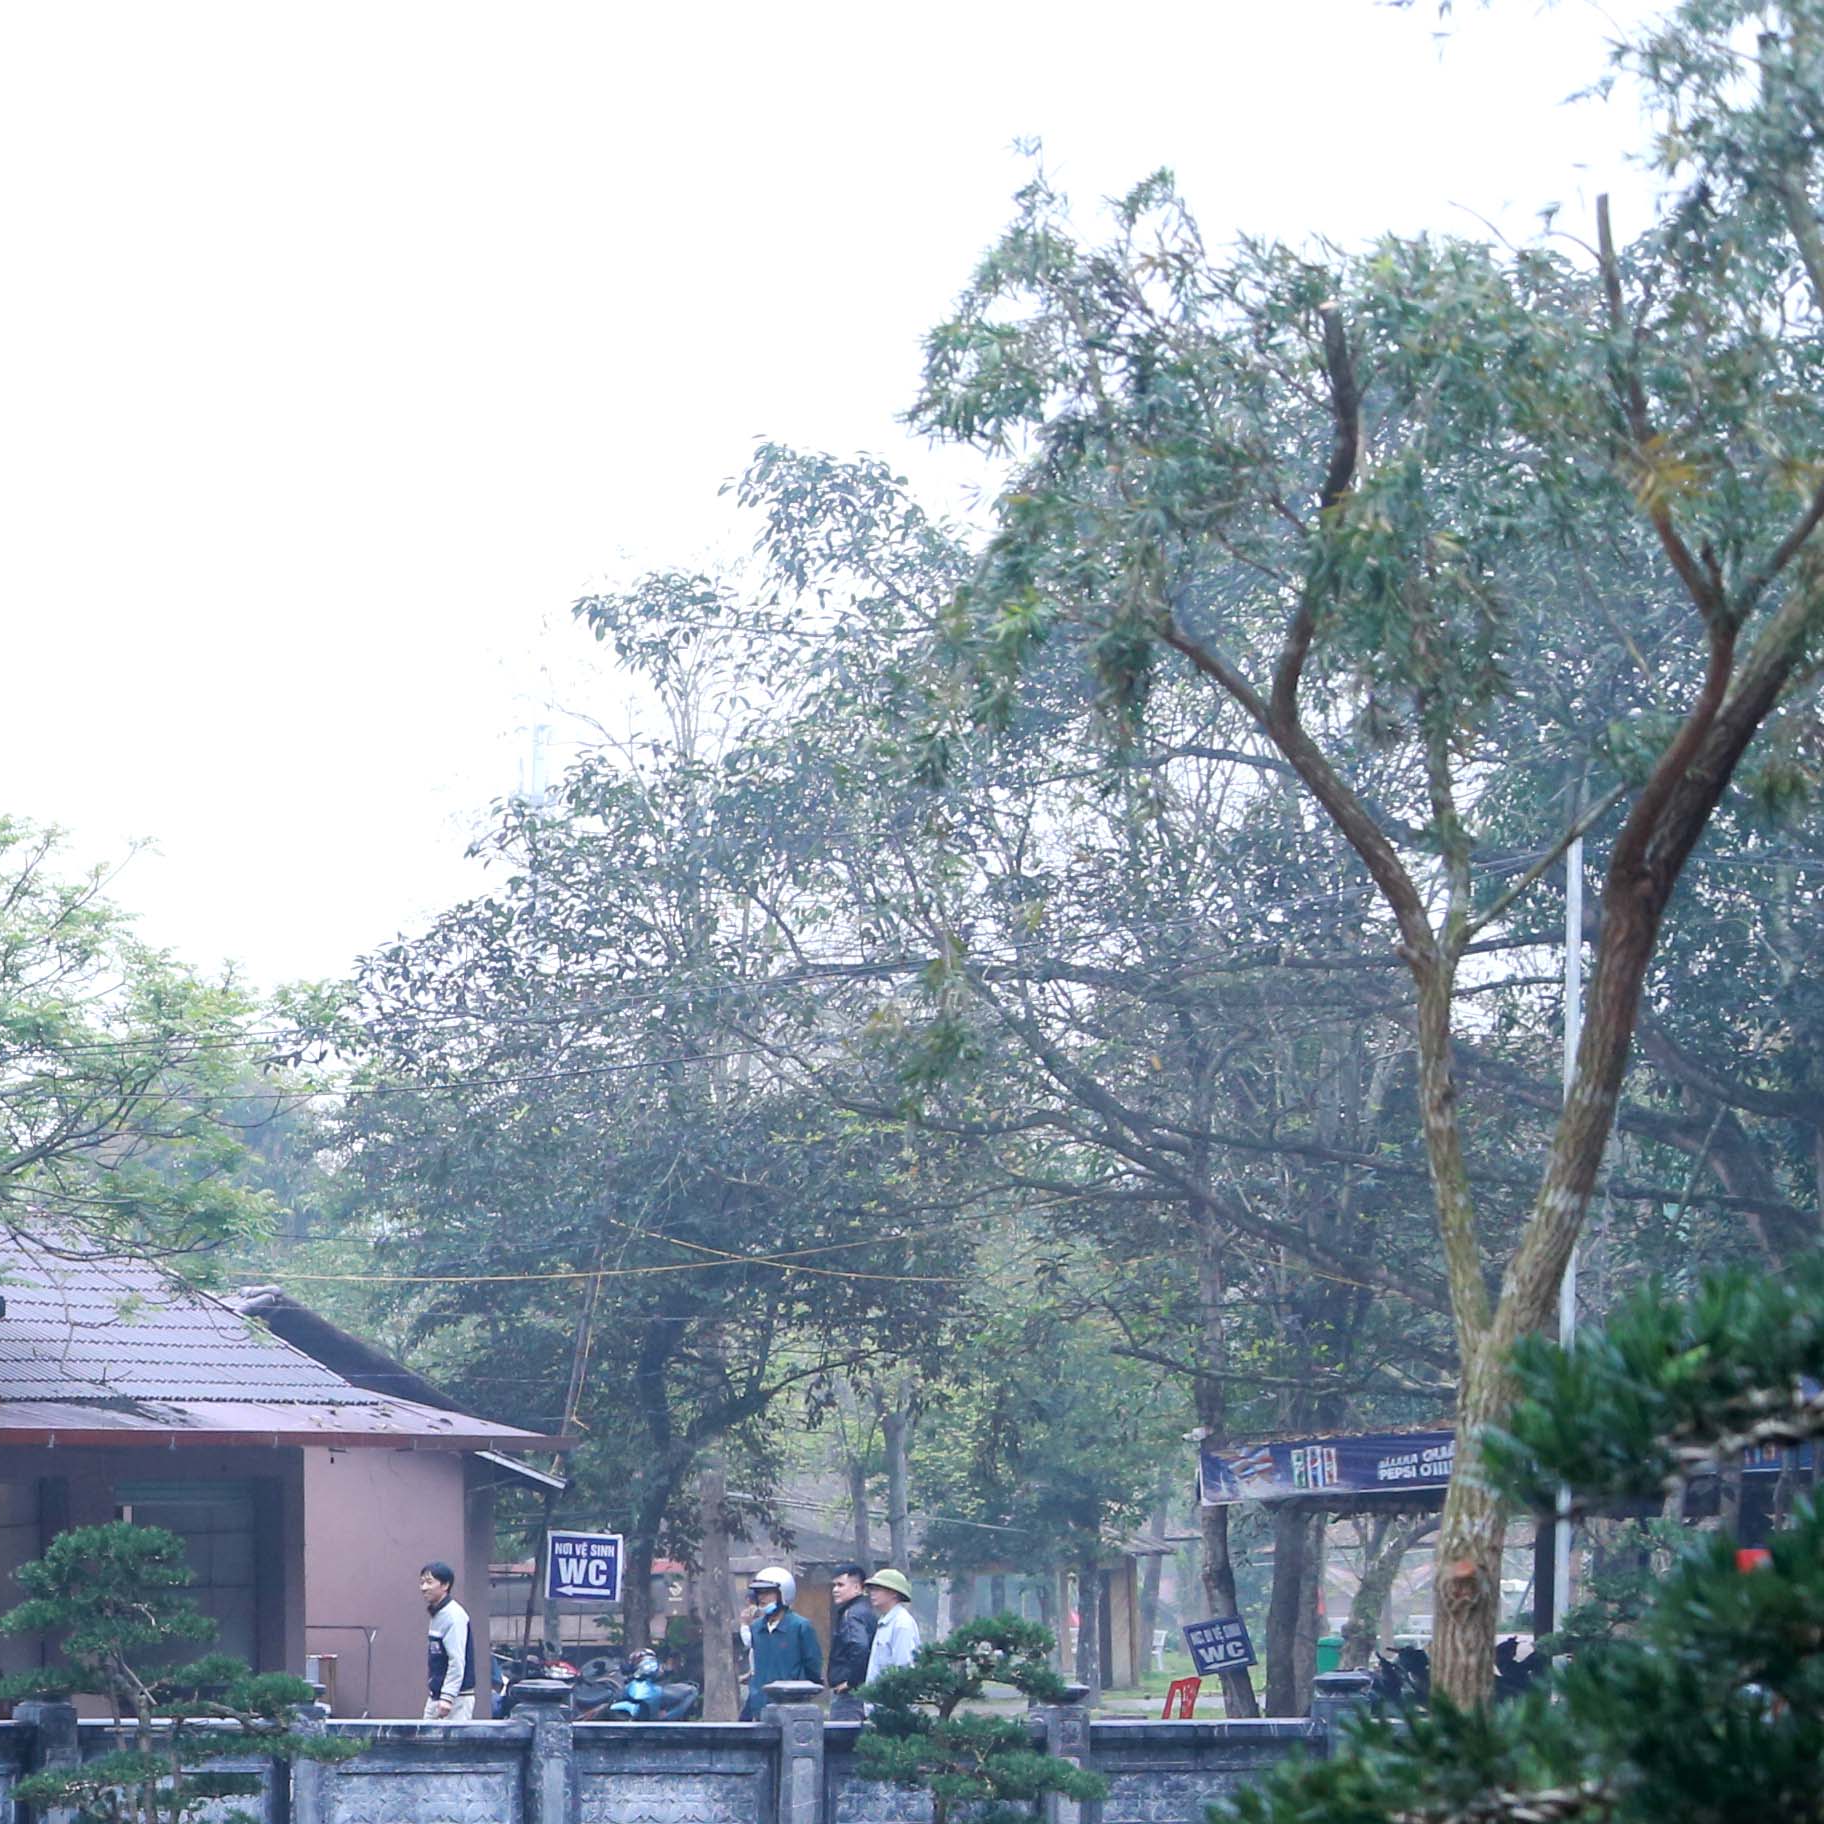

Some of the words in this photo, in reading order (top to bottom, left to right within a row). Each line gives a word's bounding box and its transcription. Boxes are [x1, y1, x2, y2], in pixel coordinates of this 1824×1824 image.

[1378, 1465, 1417, 1480] PEPSI
[555, 1542, 573, 1555] NƠI
[575, 1541, 588, 1558] VỆ
[591, 1543, 615, 1557] SINH
[558, 1557, 608, 1586] WC
[1198, 1640, 1245, 1664] WC
